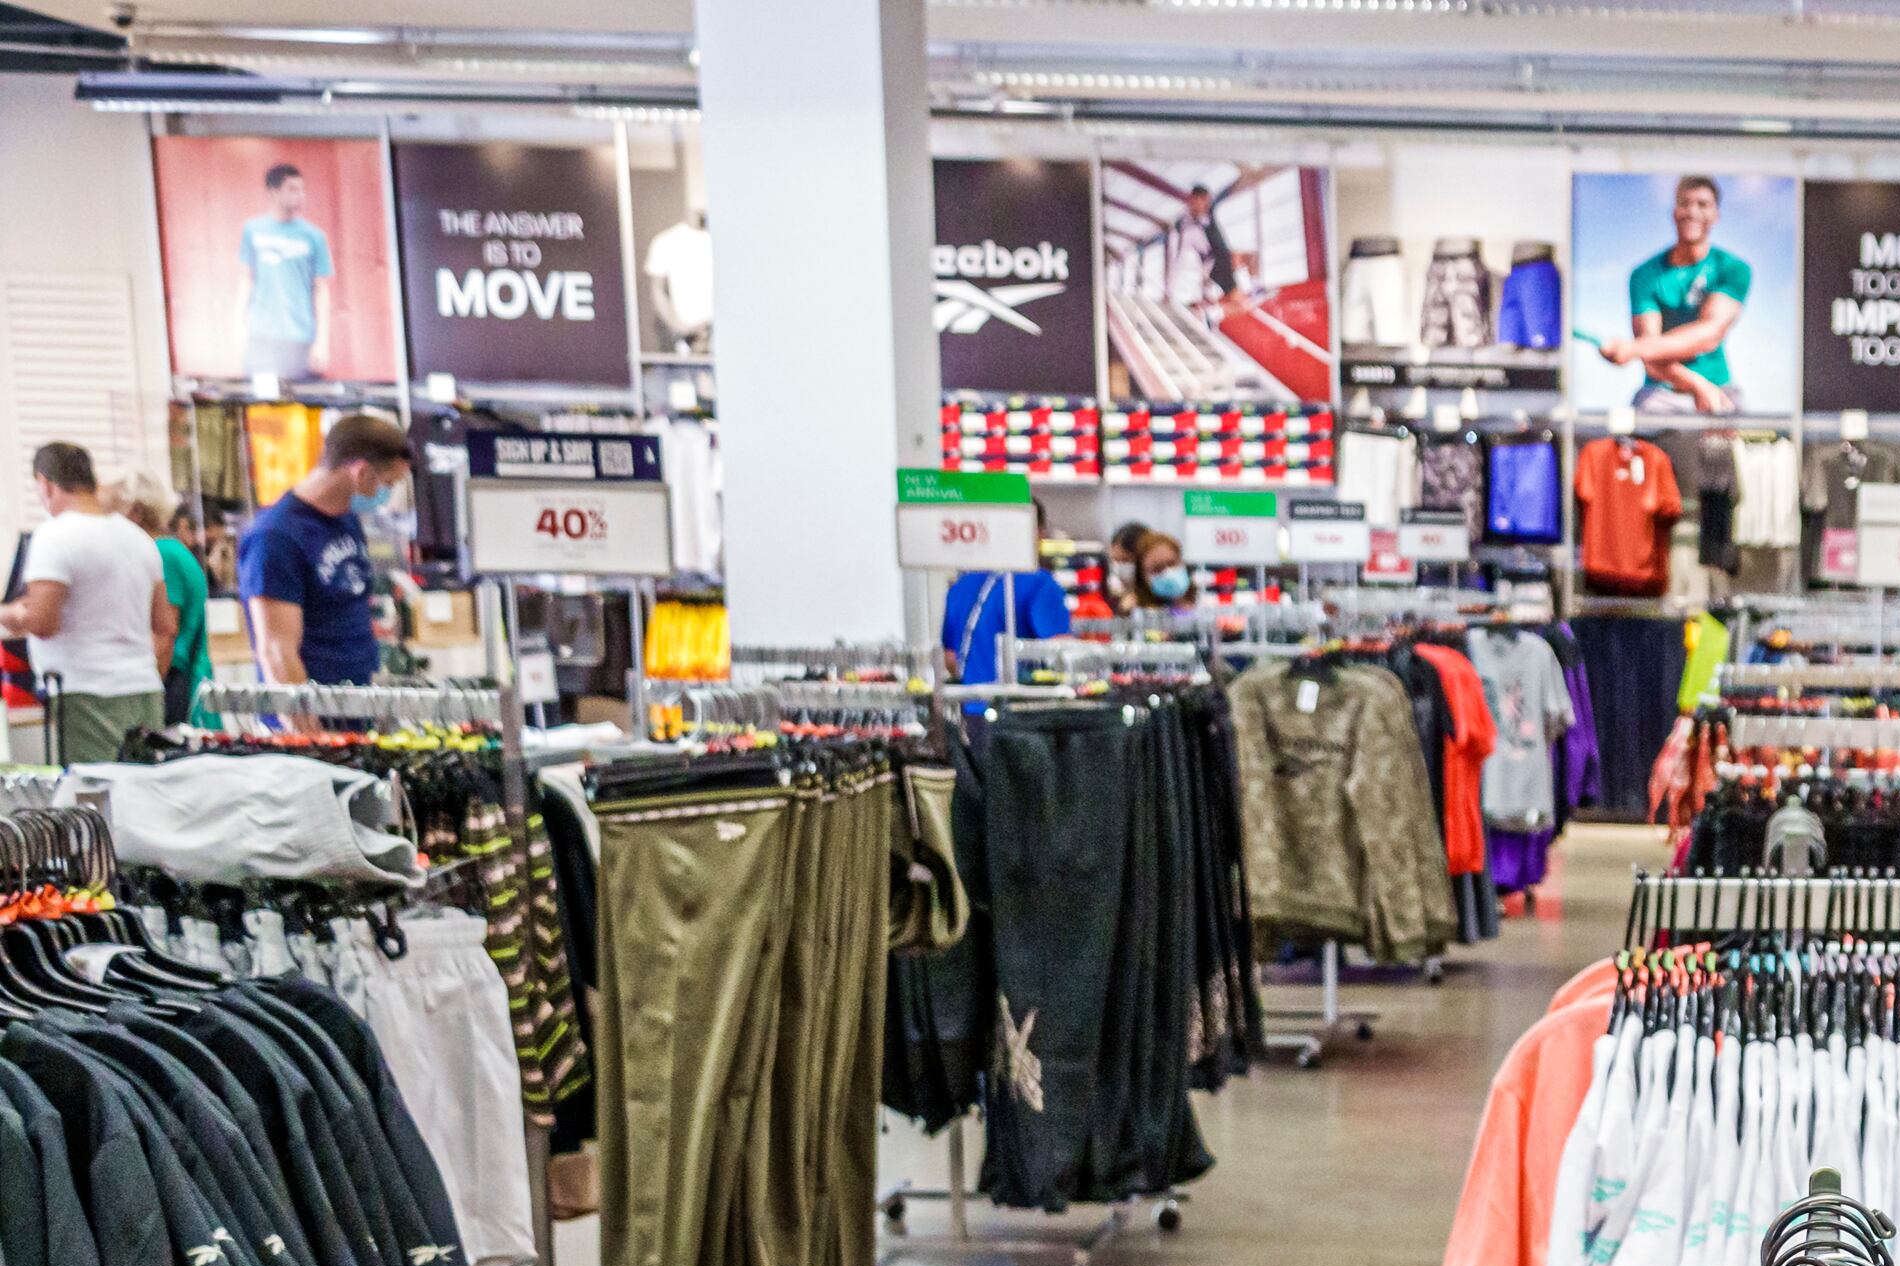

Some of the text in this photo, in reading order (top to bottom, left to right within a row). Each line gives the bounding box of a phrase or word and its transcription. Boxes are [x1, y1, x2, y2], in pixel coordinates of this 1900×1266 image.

[439, 208, 585, 241] THE ANSWER
[481, 239, 542, 269] IS TO
[931, 238, 1070, 281] eebok
[435, 267, 596, 321] MOVE
